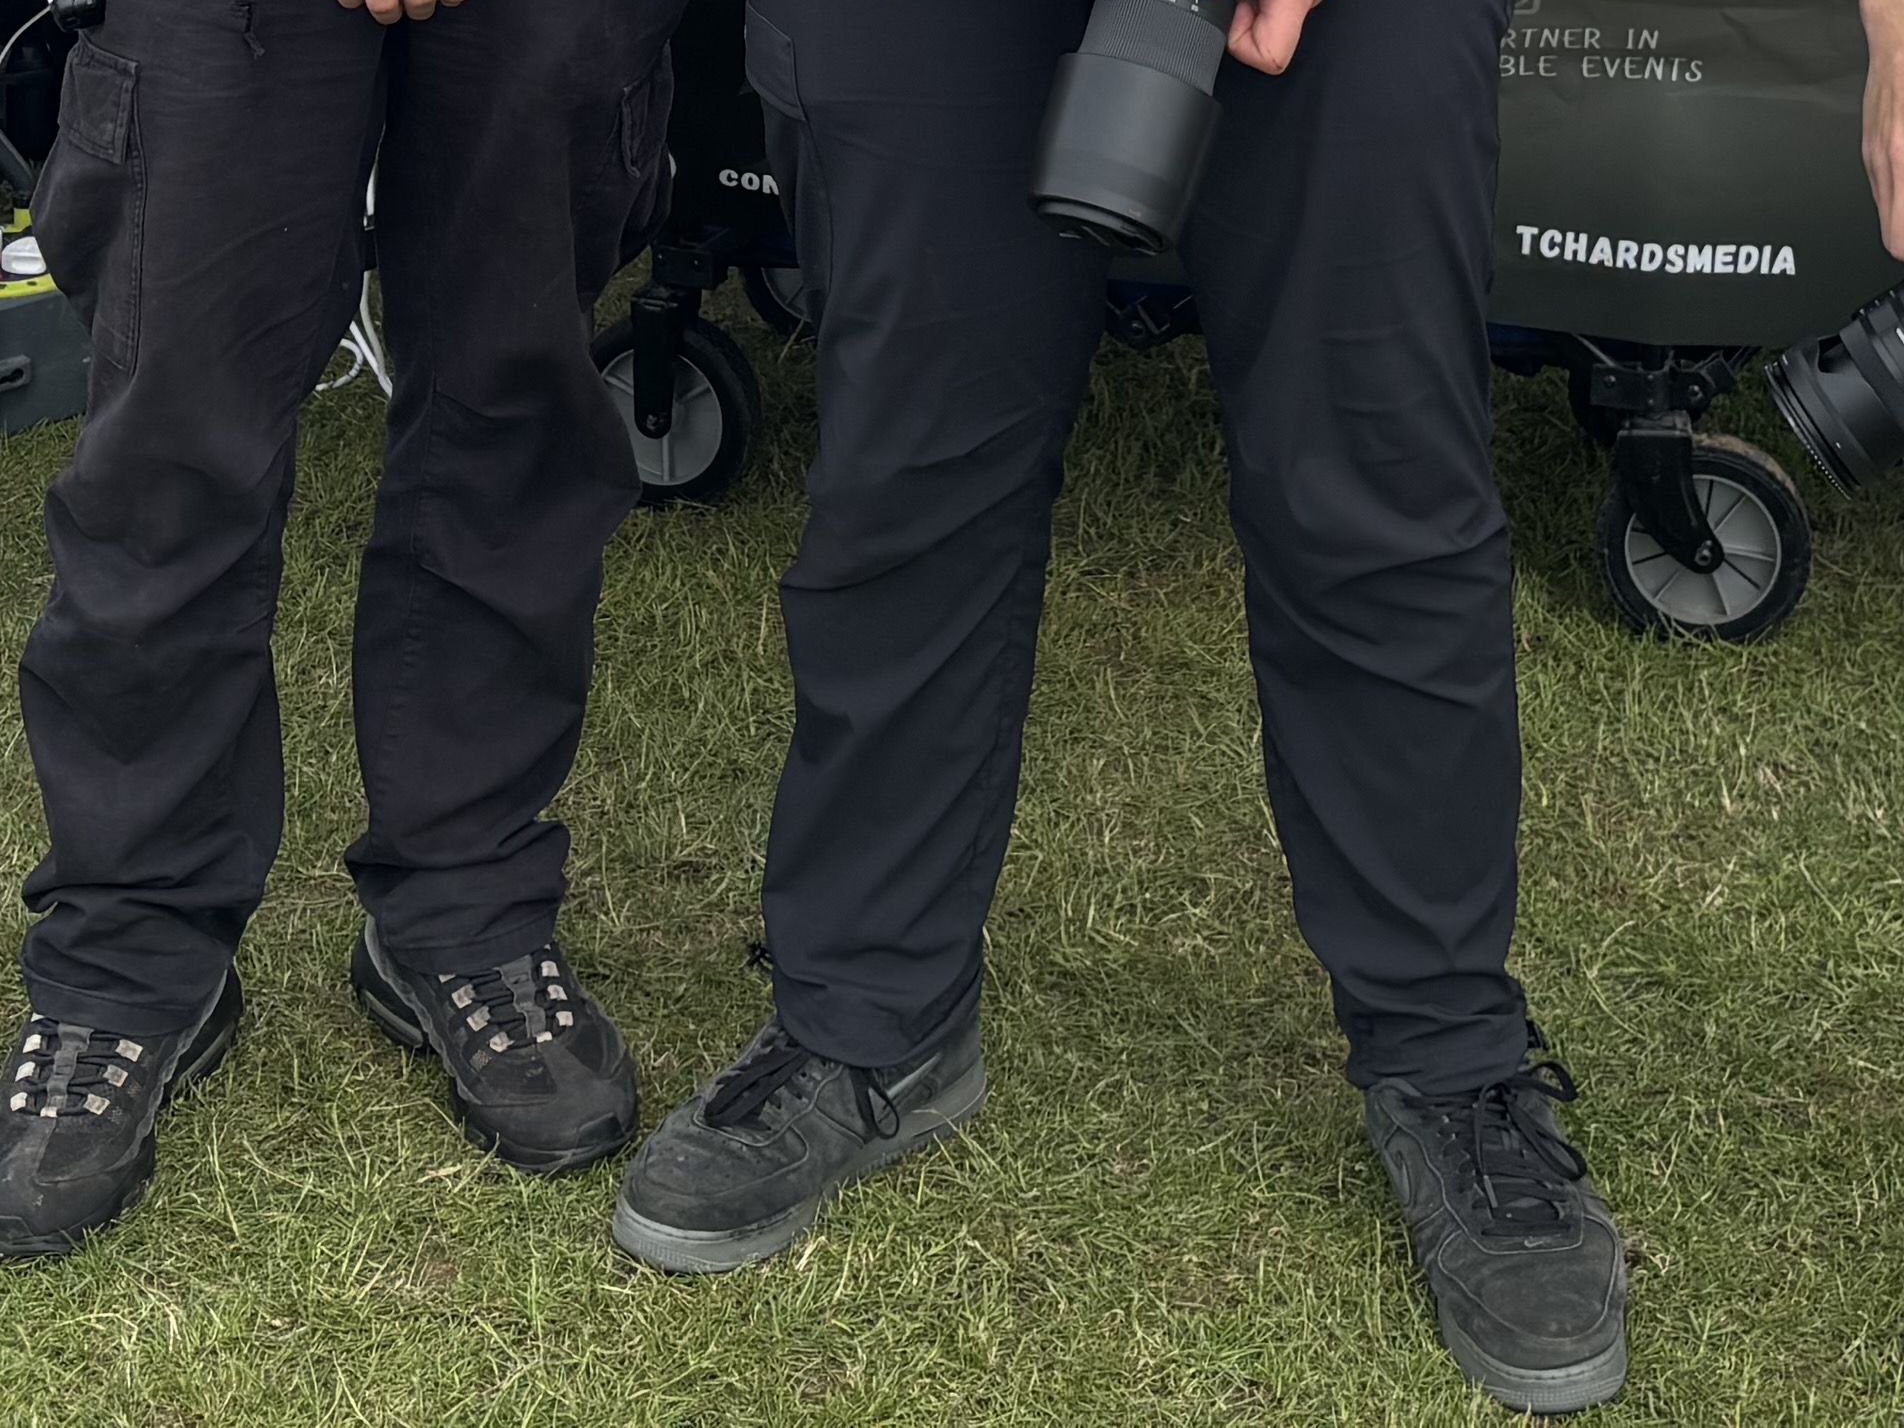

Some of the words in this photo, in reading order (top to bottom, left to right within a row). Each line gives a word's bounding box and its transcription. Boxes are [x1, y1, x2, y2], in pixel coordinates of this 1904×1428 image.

[1501, 28, 1601, 50] RTNER
[1626, 28, 1659, 50] IN
[1500, 55, 1558, 77] BLE
[1582, 56, 1703, 83] EVENTS
[719, 169, 780, 196] CON
[1516, 225, 1796, 276] TCHARDSMEDIA
